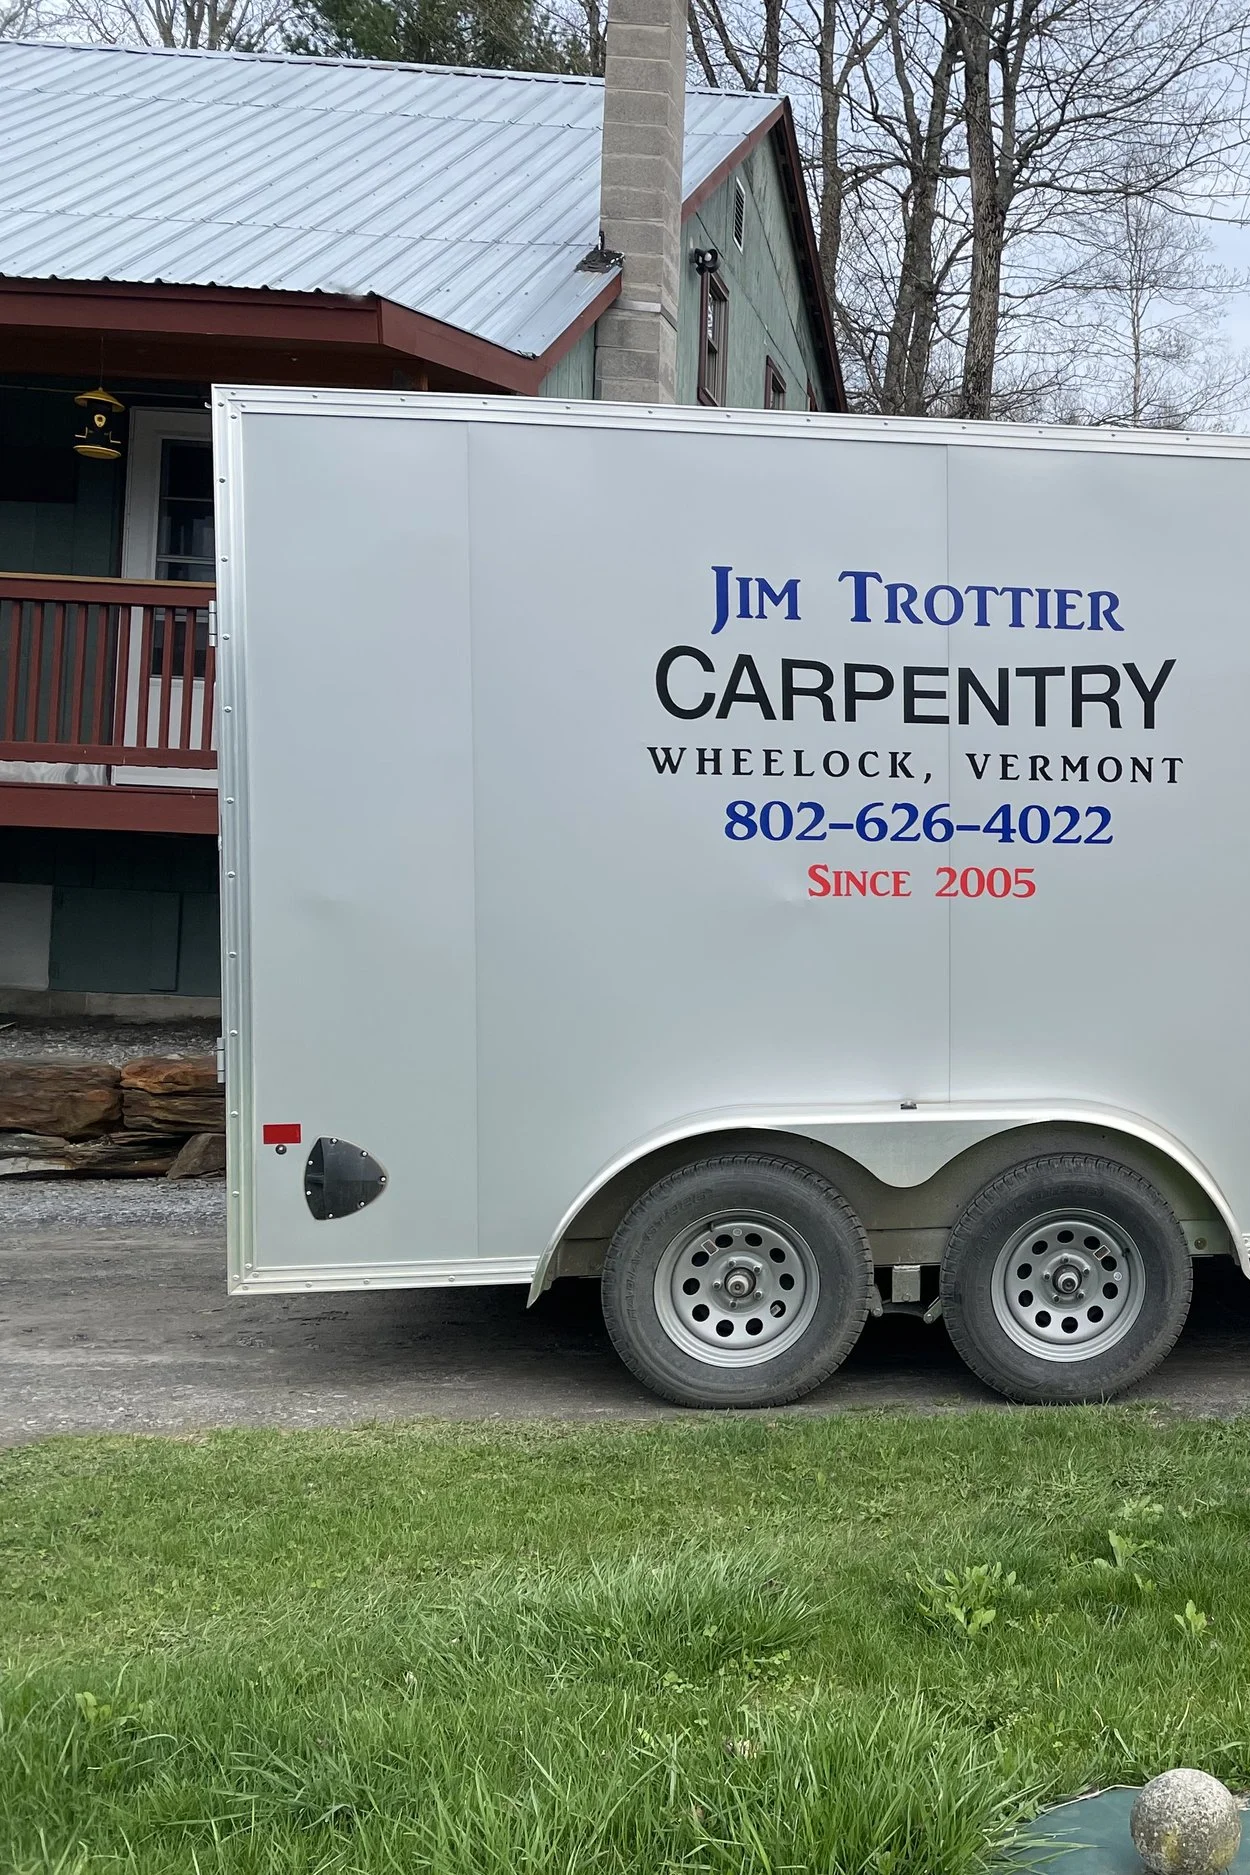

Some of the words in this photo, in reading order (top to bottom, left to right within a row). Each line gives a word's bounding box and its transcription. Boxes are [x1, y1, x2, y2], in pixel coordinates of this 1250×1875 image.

[710, 565, 802, 635] JIM
[837, 570, 1125, 632] TROTTIER
[655, 645, 1177, 730] CARPENTRY
[646, 746, 932, 784] WHEELOCK,
[964, 752, 1184, 784] VERMONT
[724, 800, 1114, 845] 802-626-4022
[935, 866, 1036, 899] 2005
